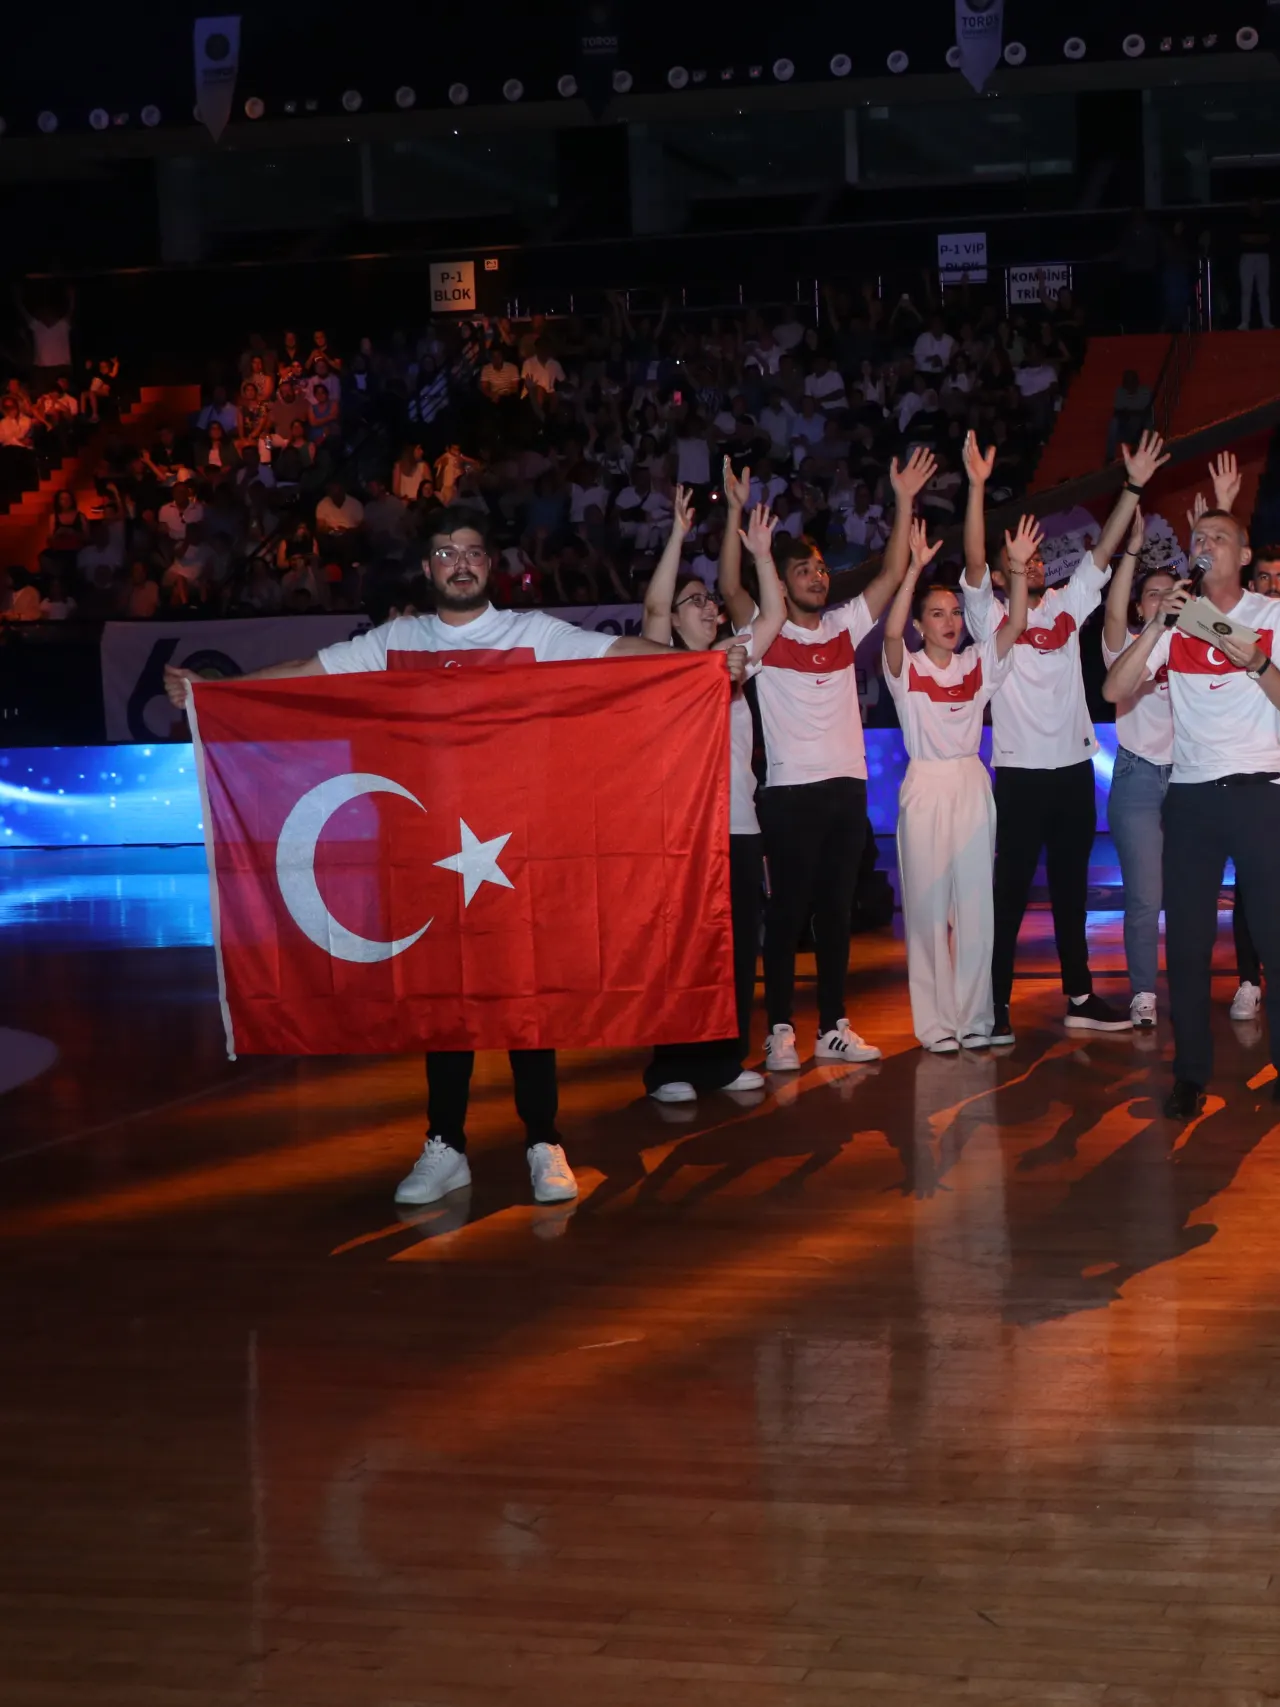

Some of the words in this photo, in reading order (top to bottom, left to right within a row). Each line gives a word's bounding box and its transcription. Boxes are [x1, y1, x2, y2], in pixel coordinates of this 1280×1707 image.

[940, 244, 960, 255] P-1
[441, 271, 463, 284] P-1
[434, 288, 471, 302] BLOK
